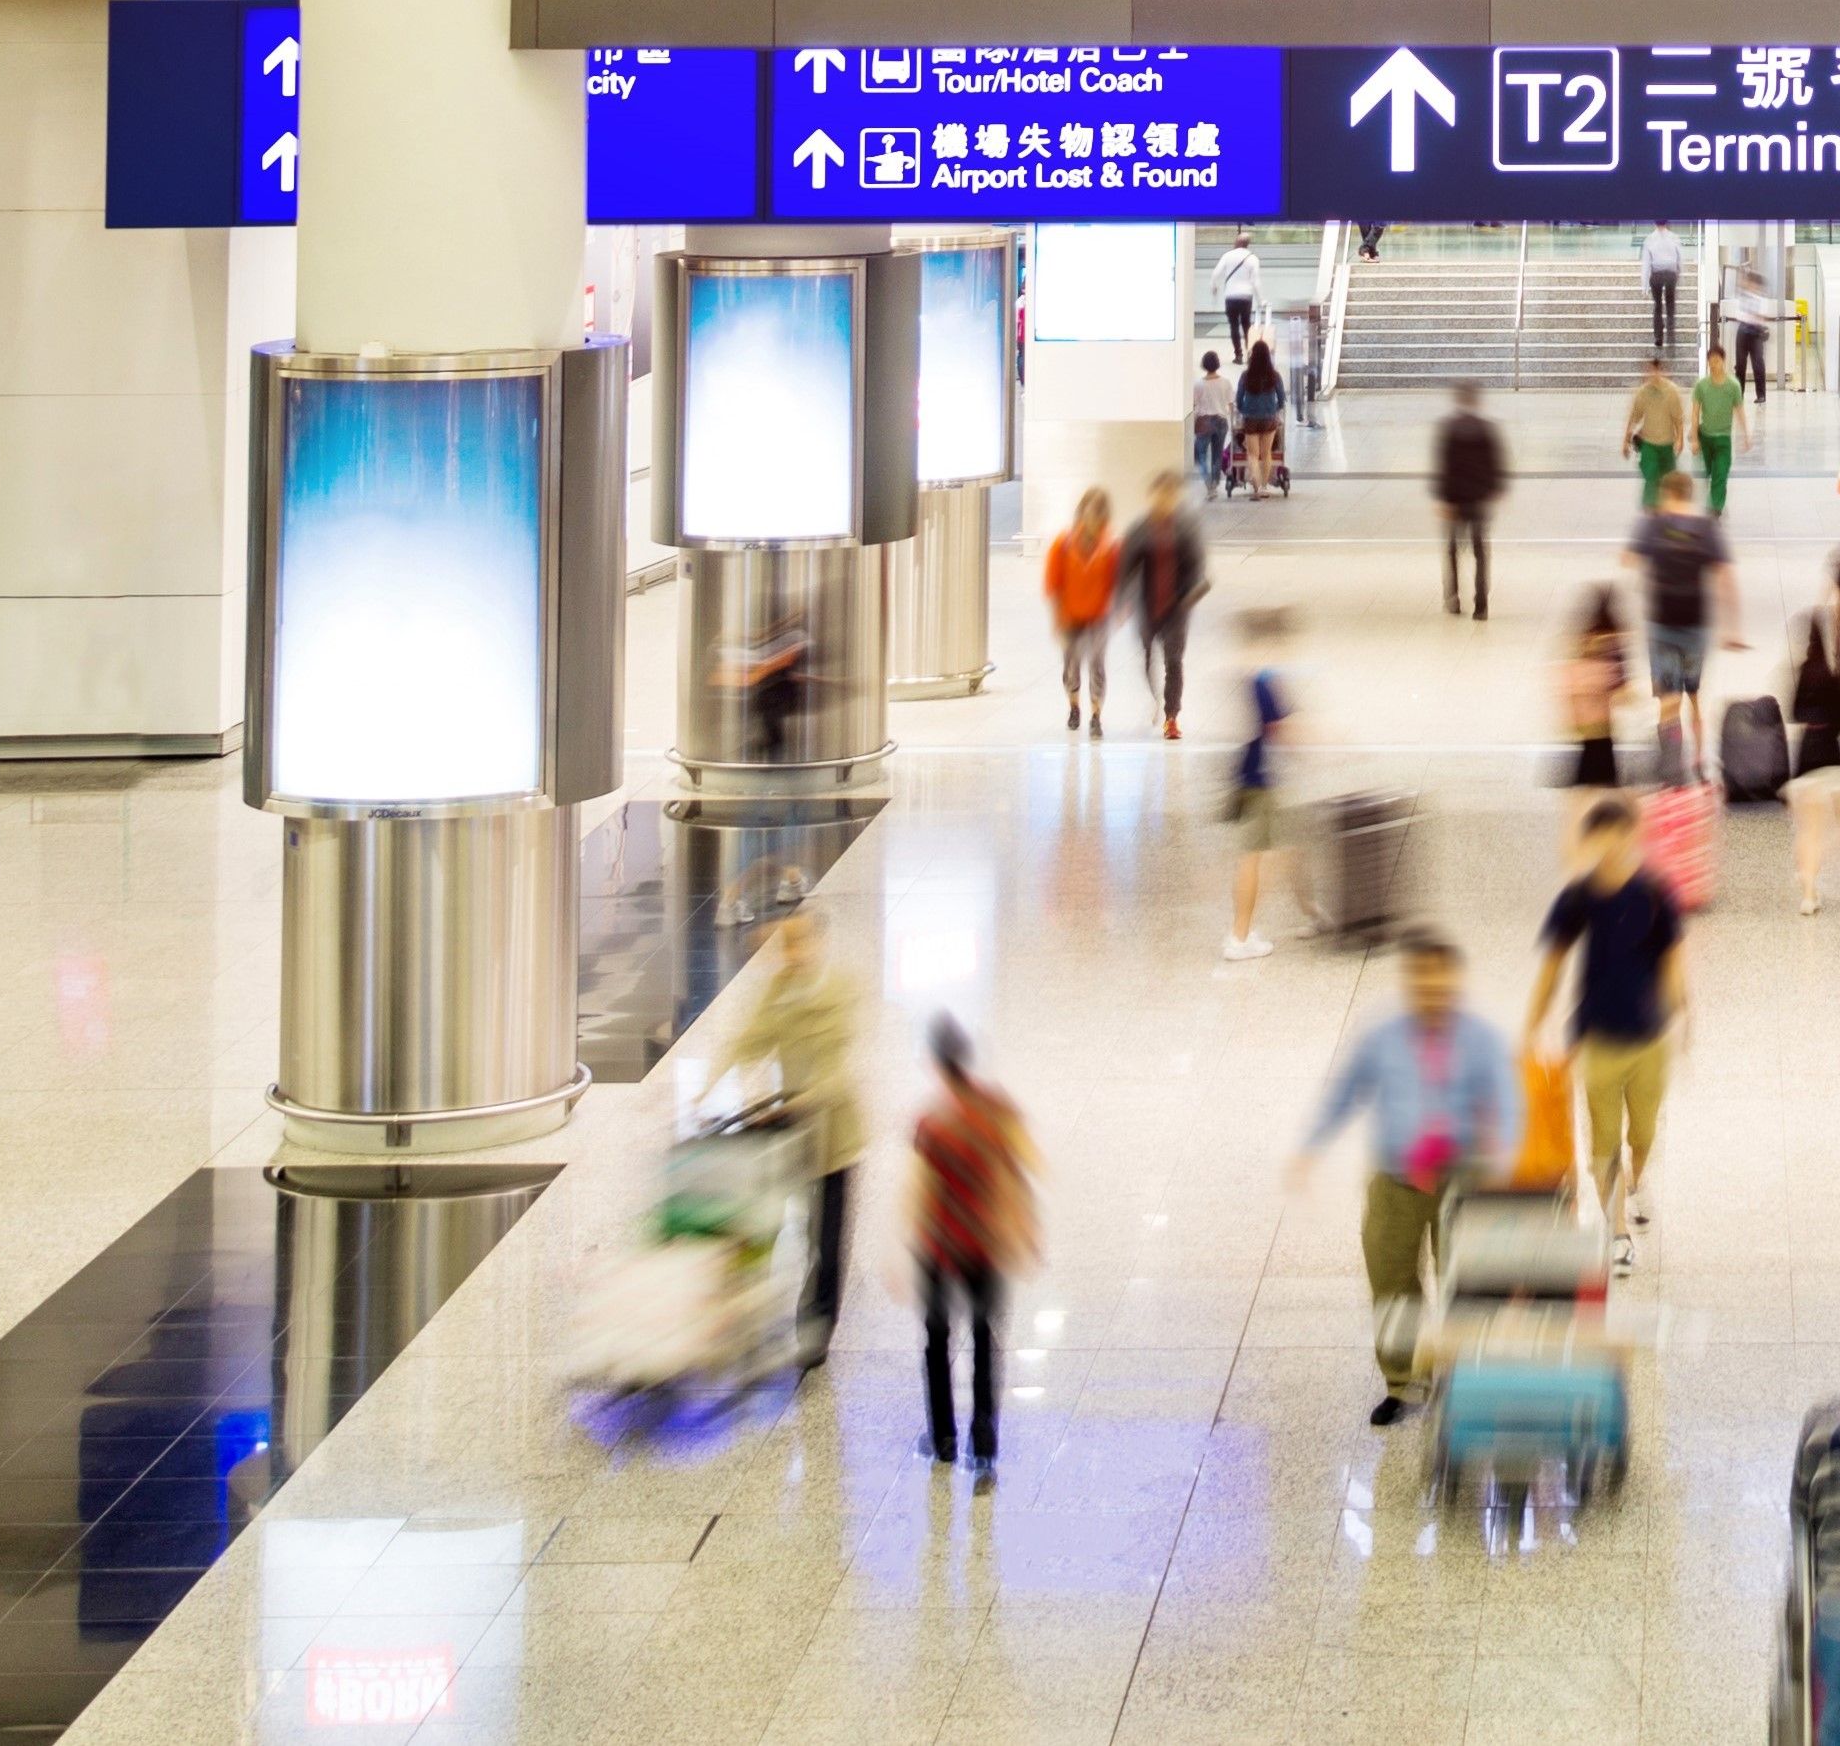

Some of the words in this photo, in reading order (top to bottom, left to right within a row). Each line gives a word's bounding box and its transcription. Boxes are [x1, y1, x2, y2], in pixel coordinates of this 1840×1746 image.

[587, 69, 637, 100] city
[932, 68, 1070, 94] Tour/Hotel
[1079, 67, 1163, 93] Coach
[1506, 74, 1607, 142] T2
[932, 122, 1221, 159] 機場失物認領處
[932, 164, 1028, 194] Airport
[1036, 163, 1093, 188] Lost
[1100, 162, 1124, 188] &
[1132, 162, 1218, 188] Found
[368, 808, 422, 819] JCDecaux
